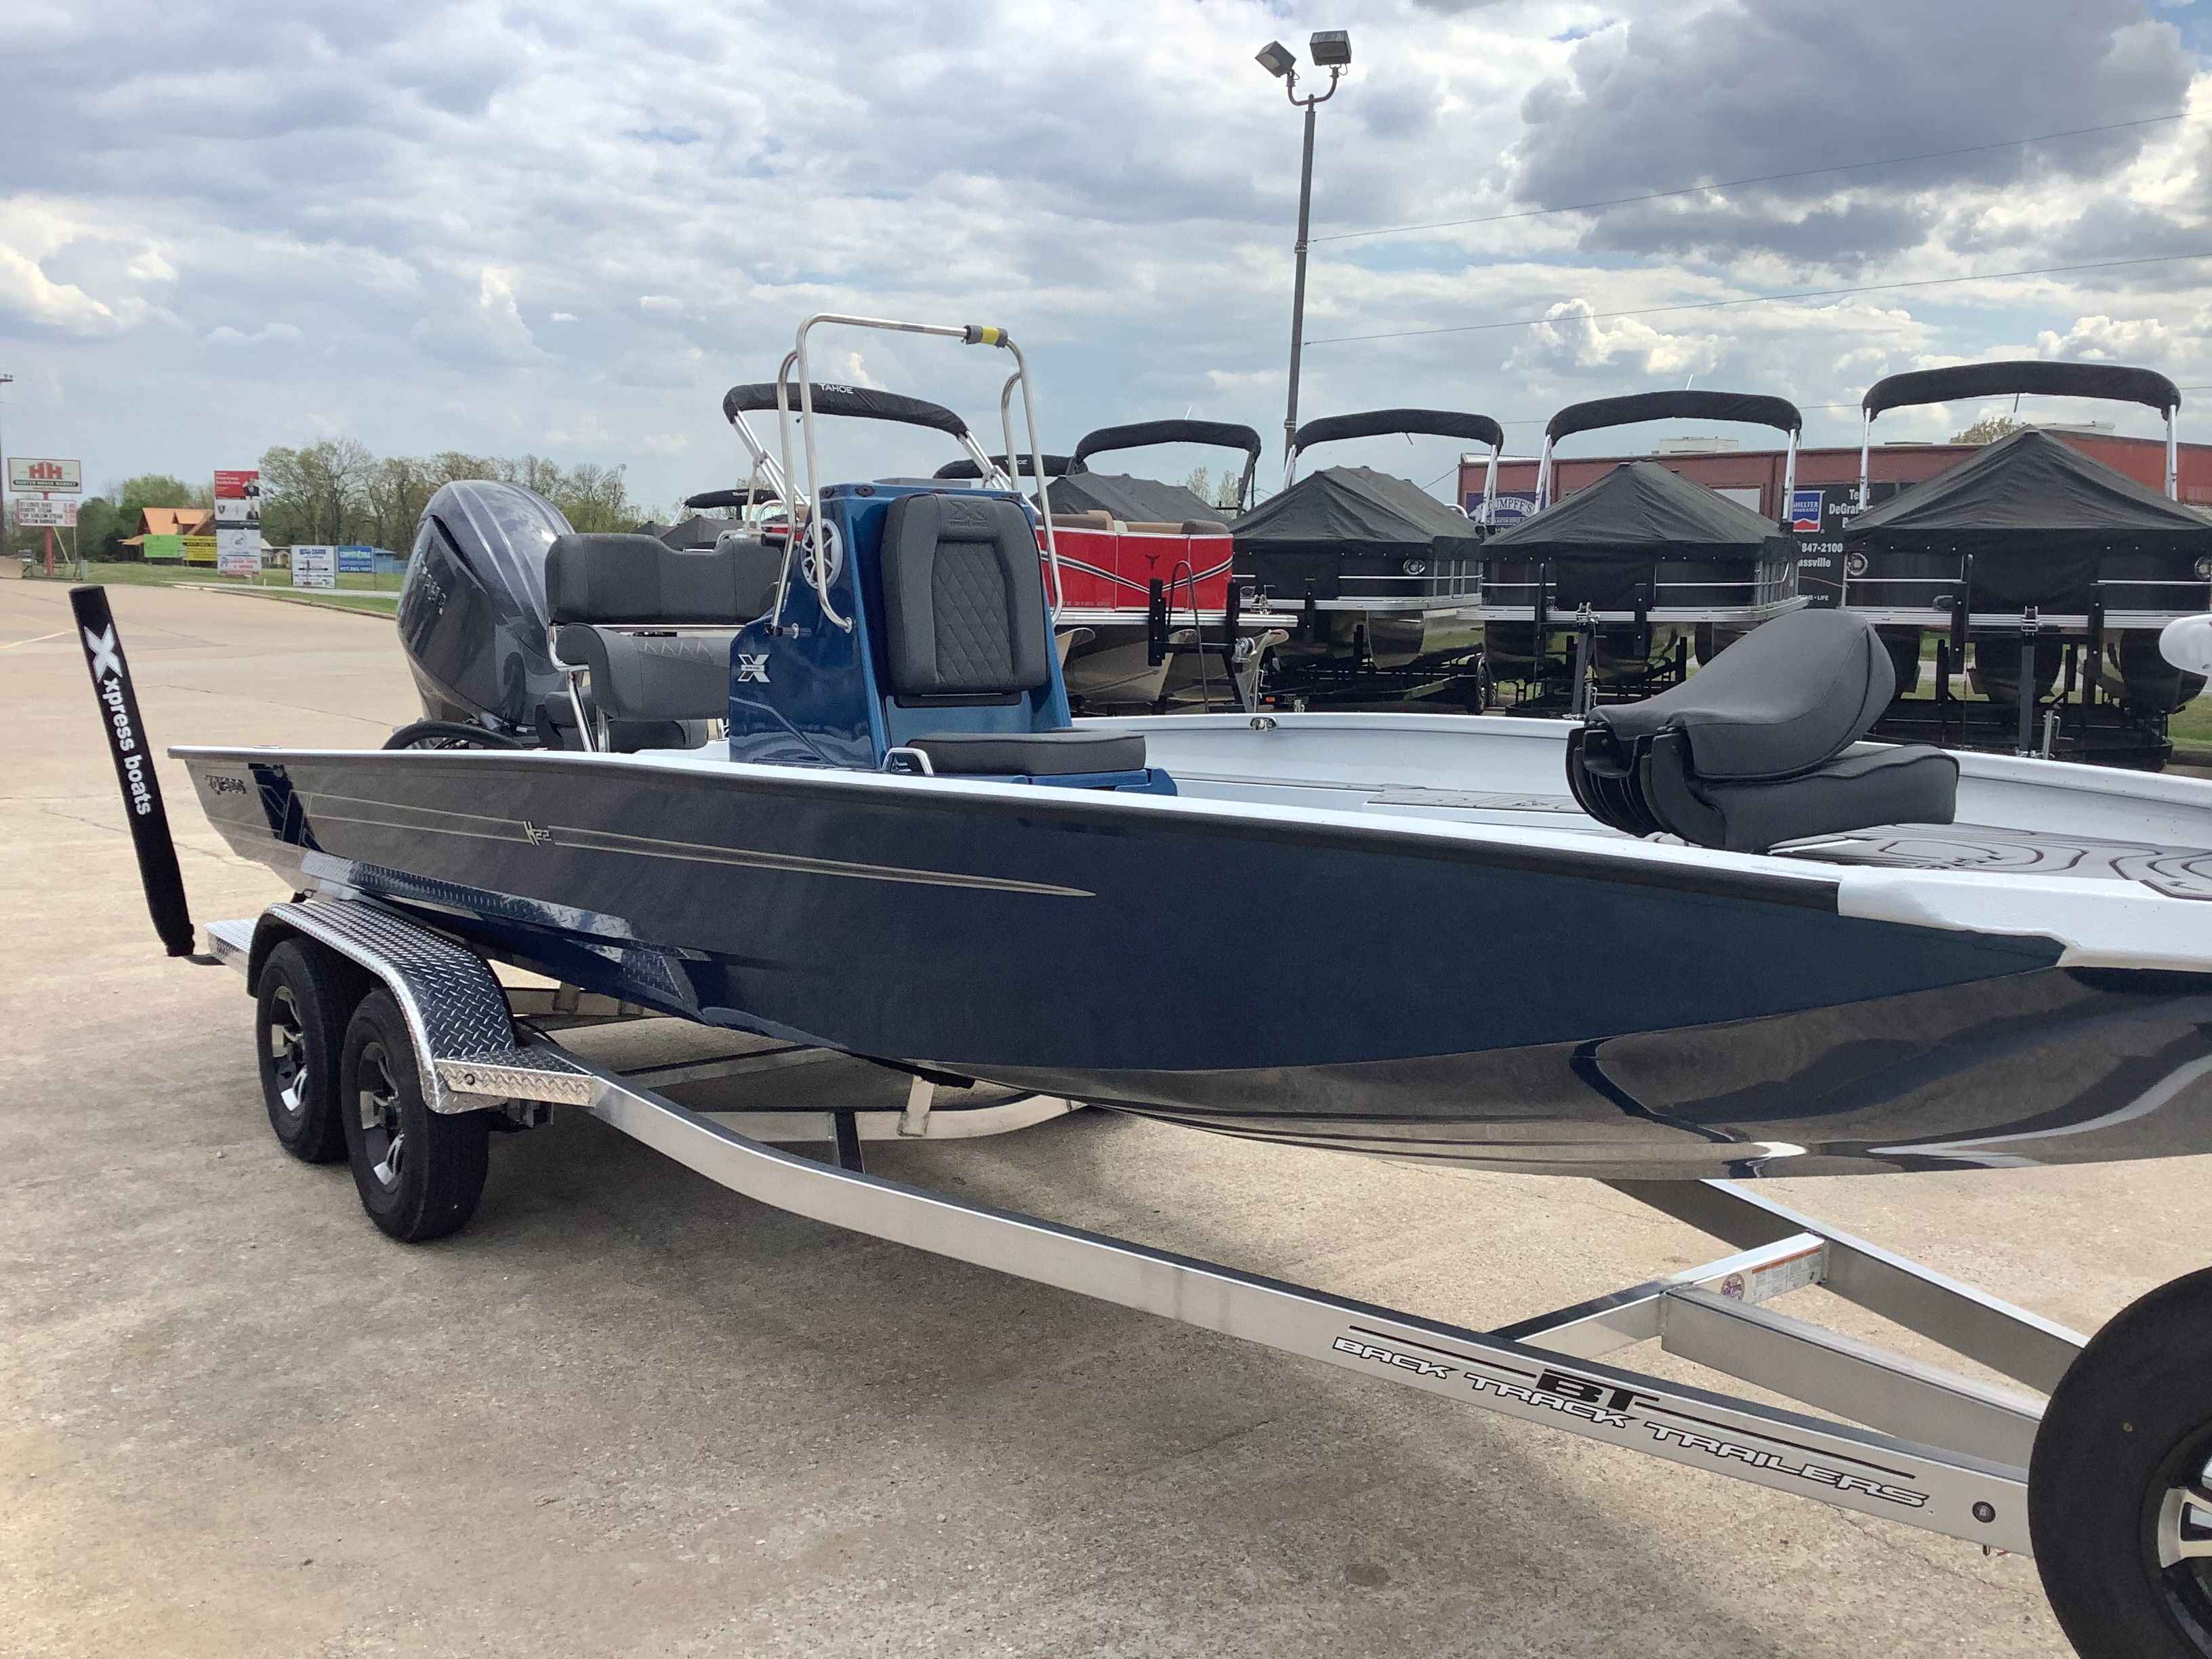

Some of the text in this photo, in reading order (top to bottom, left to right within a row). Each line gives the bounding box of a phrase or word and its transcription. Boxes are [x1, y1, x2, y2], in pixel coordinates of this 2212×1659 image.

[817, 383, 854, 394] TAHOE
[1801, 543, 1843, 552] 847-2100
[1799, 557, 1831, 567] assville
[83, 623, 151, 815] X xpress boats
[1332, 1337, 1929, 1507] BACK TRACK TRAILERS
